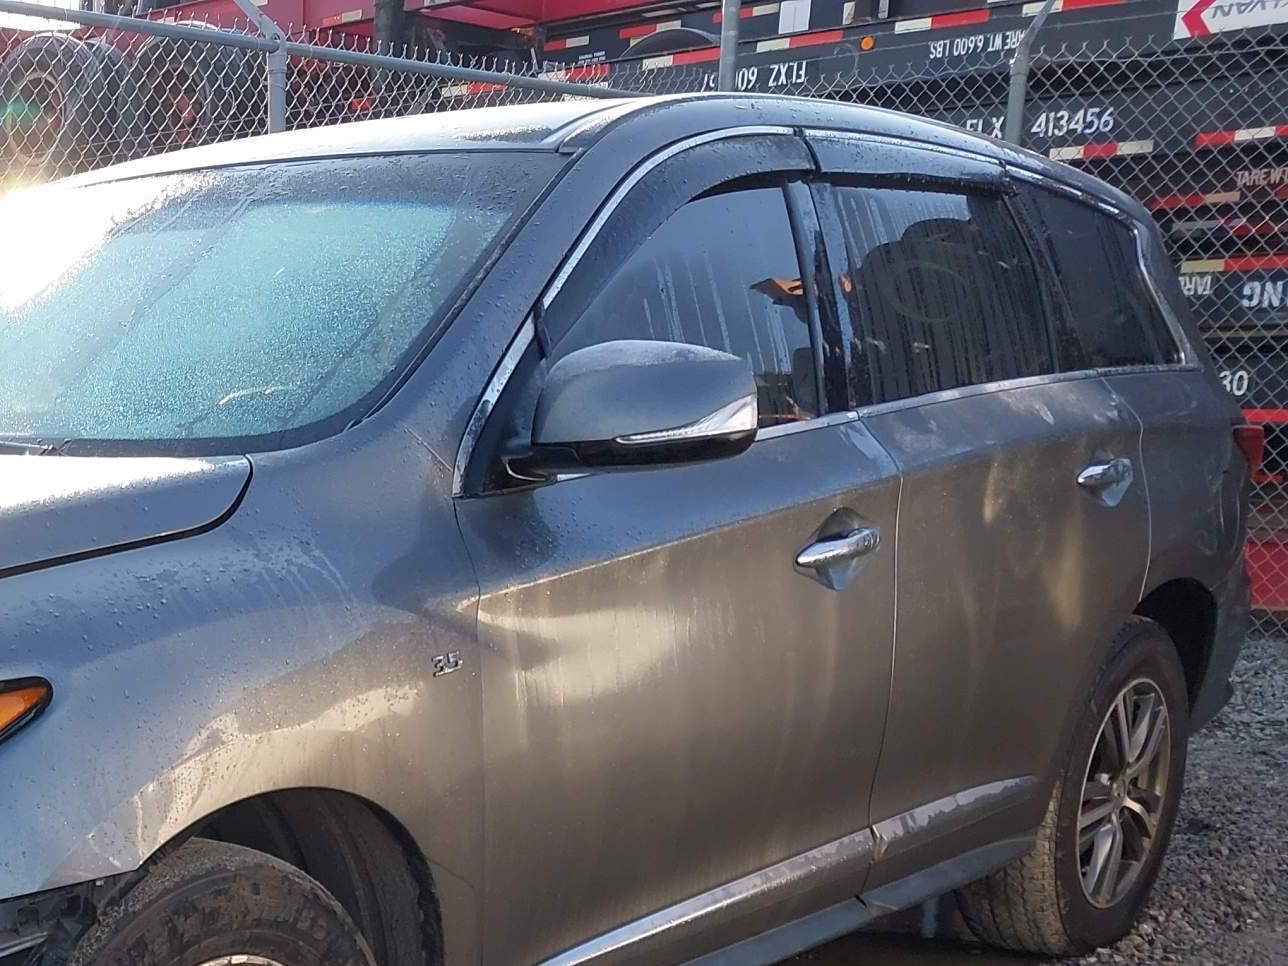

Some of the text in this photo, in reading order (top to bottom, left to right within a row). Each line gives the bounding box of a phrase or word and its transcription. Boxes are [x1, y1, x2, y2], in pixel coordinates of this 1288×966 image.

[1005, 30, 1028, 50] ARE
[767, 61, 807, 87] FLXZ
[1031, 107, 1114, 138] 413456
